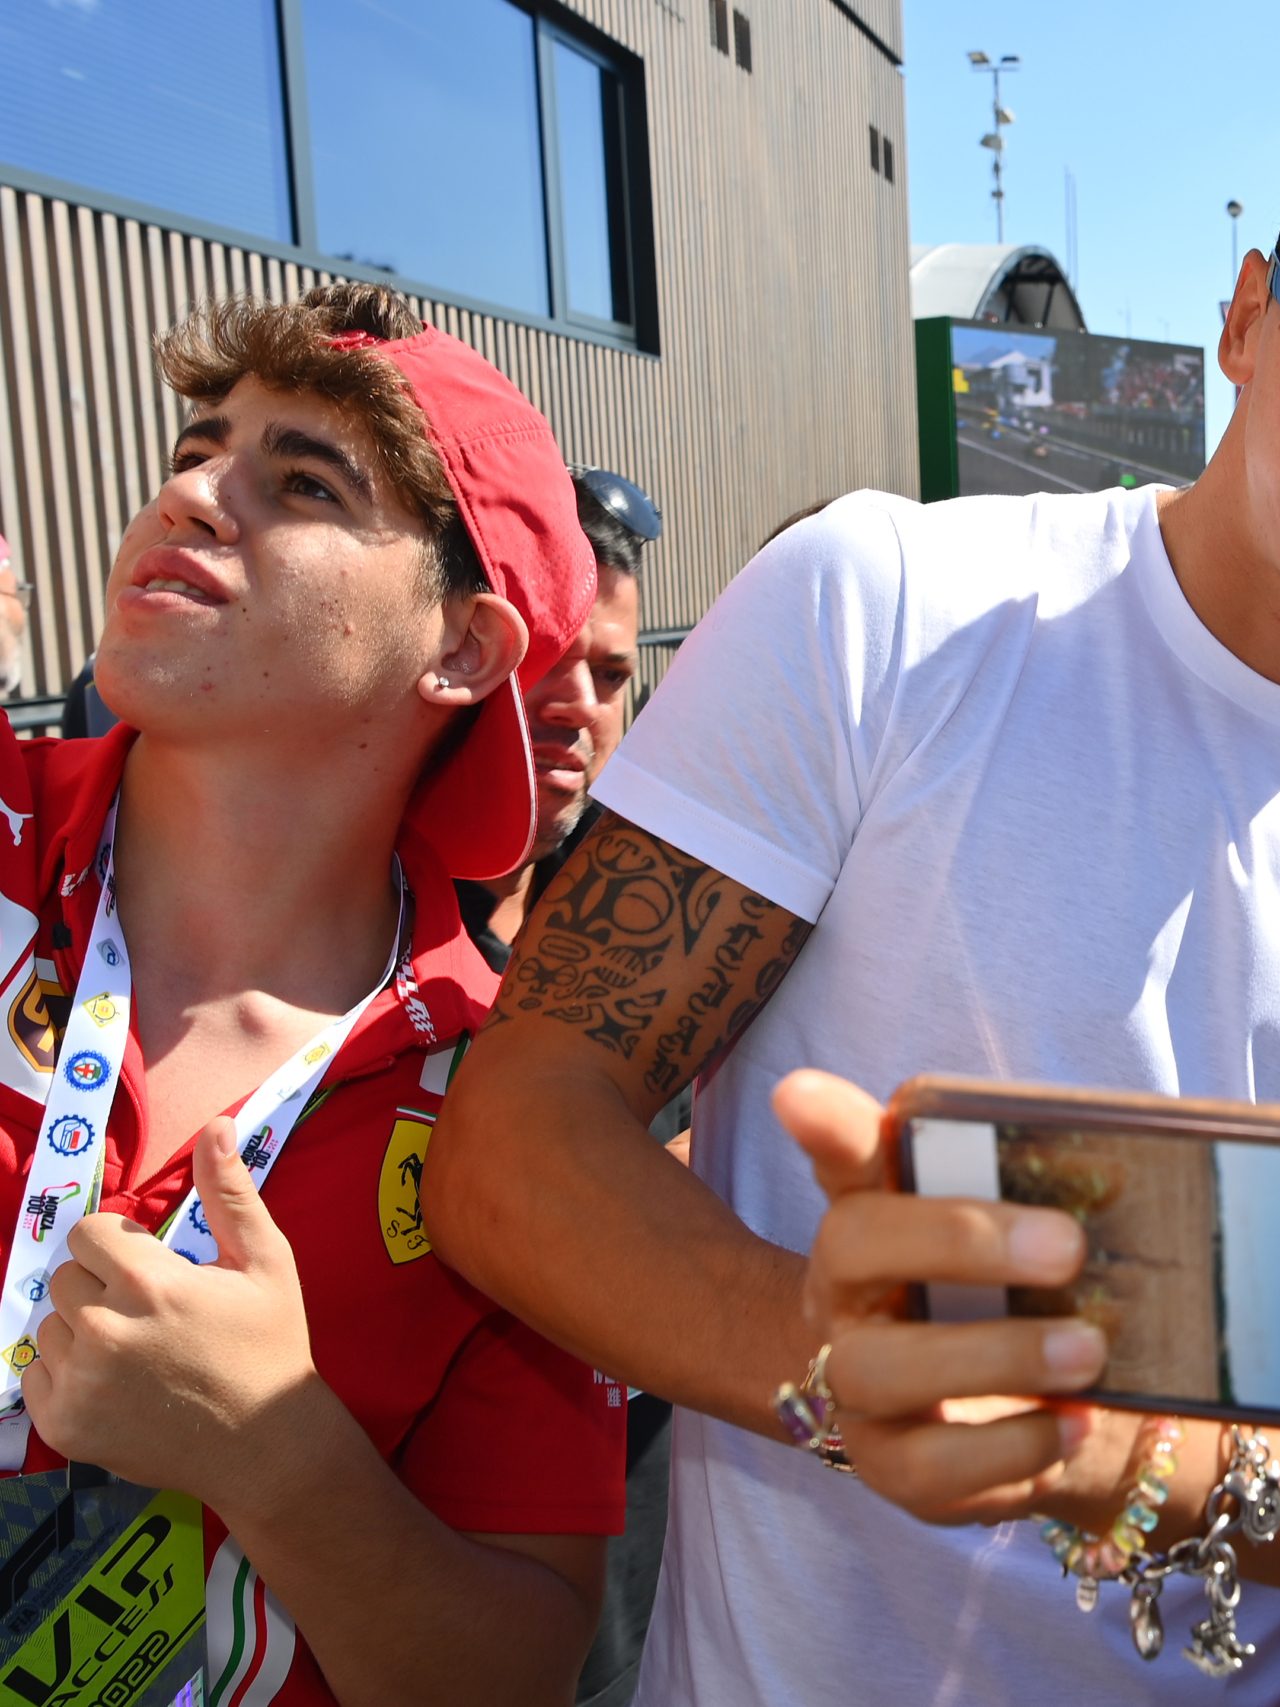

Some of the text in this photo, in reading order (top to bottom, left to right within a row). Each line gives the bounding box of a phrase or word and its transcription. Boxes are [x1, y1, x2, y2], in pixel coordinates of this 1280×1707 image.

[26, 1195, 46, 1215] 100
[40, 1195, 59, 1230] MONZA
[3, 1515, 172, 1707] VIP
[46, 1563, 174, 1707] ACCESS
[88, 1630, 169, 1707] 022
